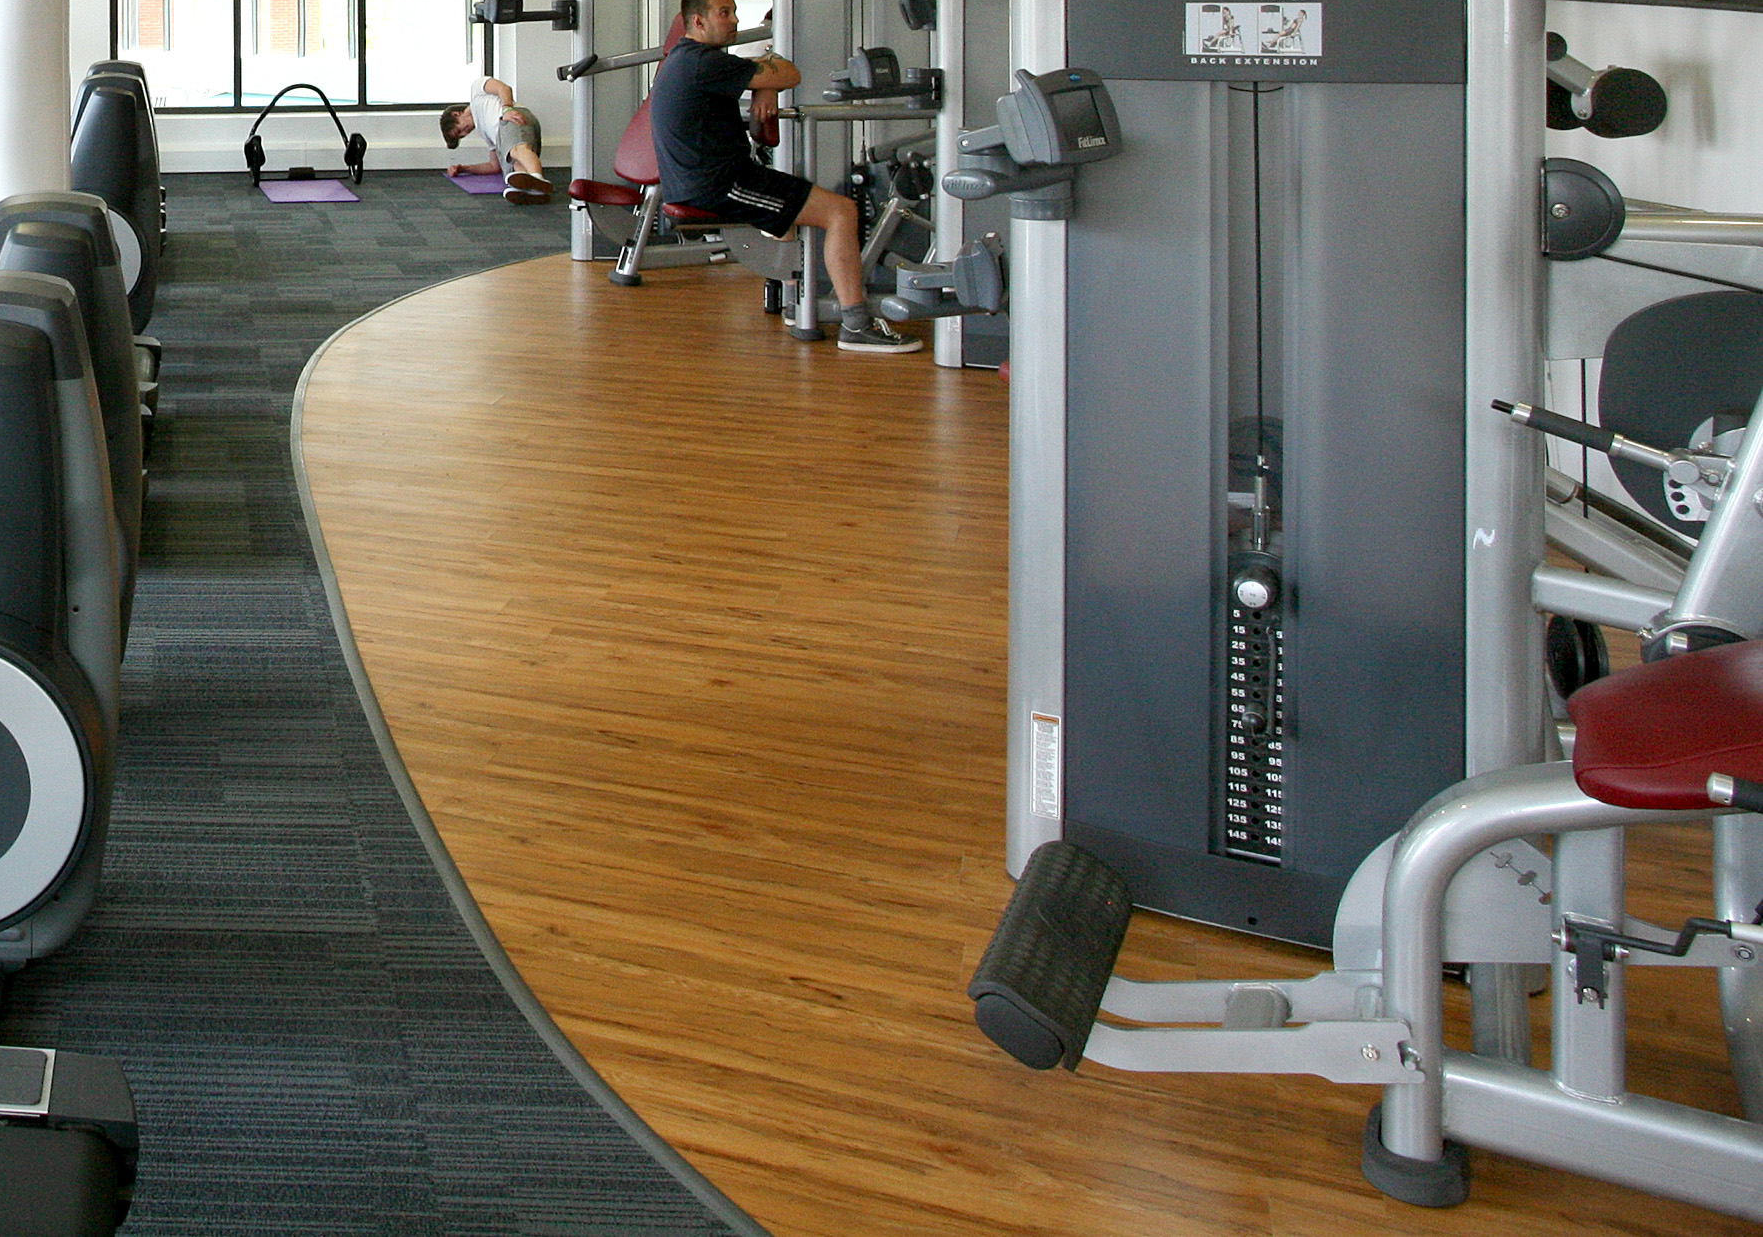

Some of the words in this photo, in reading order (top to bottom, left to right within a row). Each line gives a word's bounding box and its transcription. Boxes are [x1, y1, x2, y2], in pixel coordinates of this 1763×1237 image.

[1190, 57, 1227, 65] BACK
[1234, 57, 1318, 66] EXTENSION
[1233, 609, 1240, 618] 5
[1232, 625, 1246, 634] 15
[1231, 640, 1246, 650] 25
[1231, 656, 1245, 666] 35
[1230, 672, 1245, 681] 45
[1231, 688, 1245, 697] 55
[1231, 703, 1245, 713] 65
[1230, 735, 1245, 744] 85
[1230, 750, 1245, 760] 95
[1268, 757, 1282, 767] 95
[1228, 766, 1248, 777] 105
[1227, 782, 1247, 792] 115
[1227, 797, 1247, 808] 125
[1227, 813, 1247, 824] 135
[1227, 829, 1247, 840] 145
